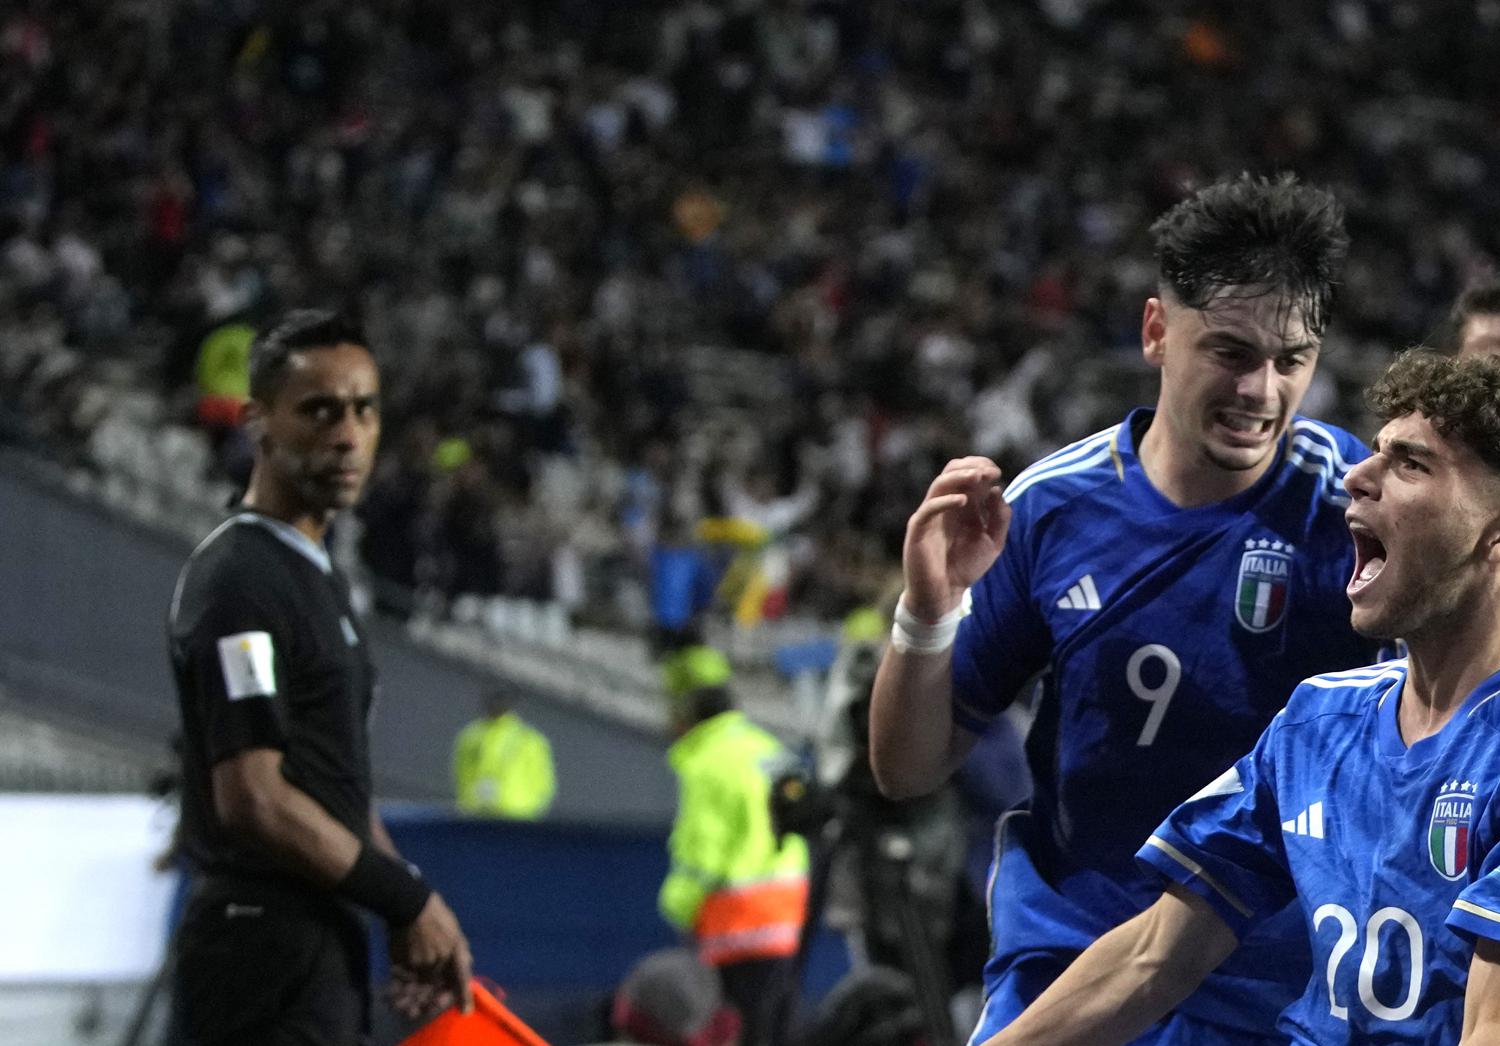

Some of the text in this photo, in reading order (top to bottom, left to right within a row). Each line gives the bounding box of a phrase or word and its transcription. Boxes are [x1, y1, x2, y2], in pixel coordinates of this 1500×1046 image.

[1244, 556, 1288, 577] ITALIA
[1126, 644, 1182, 746] 9
[1435, 801, 1472, 818] ITALIA
[1312, 902, 1423, 1021] 20
